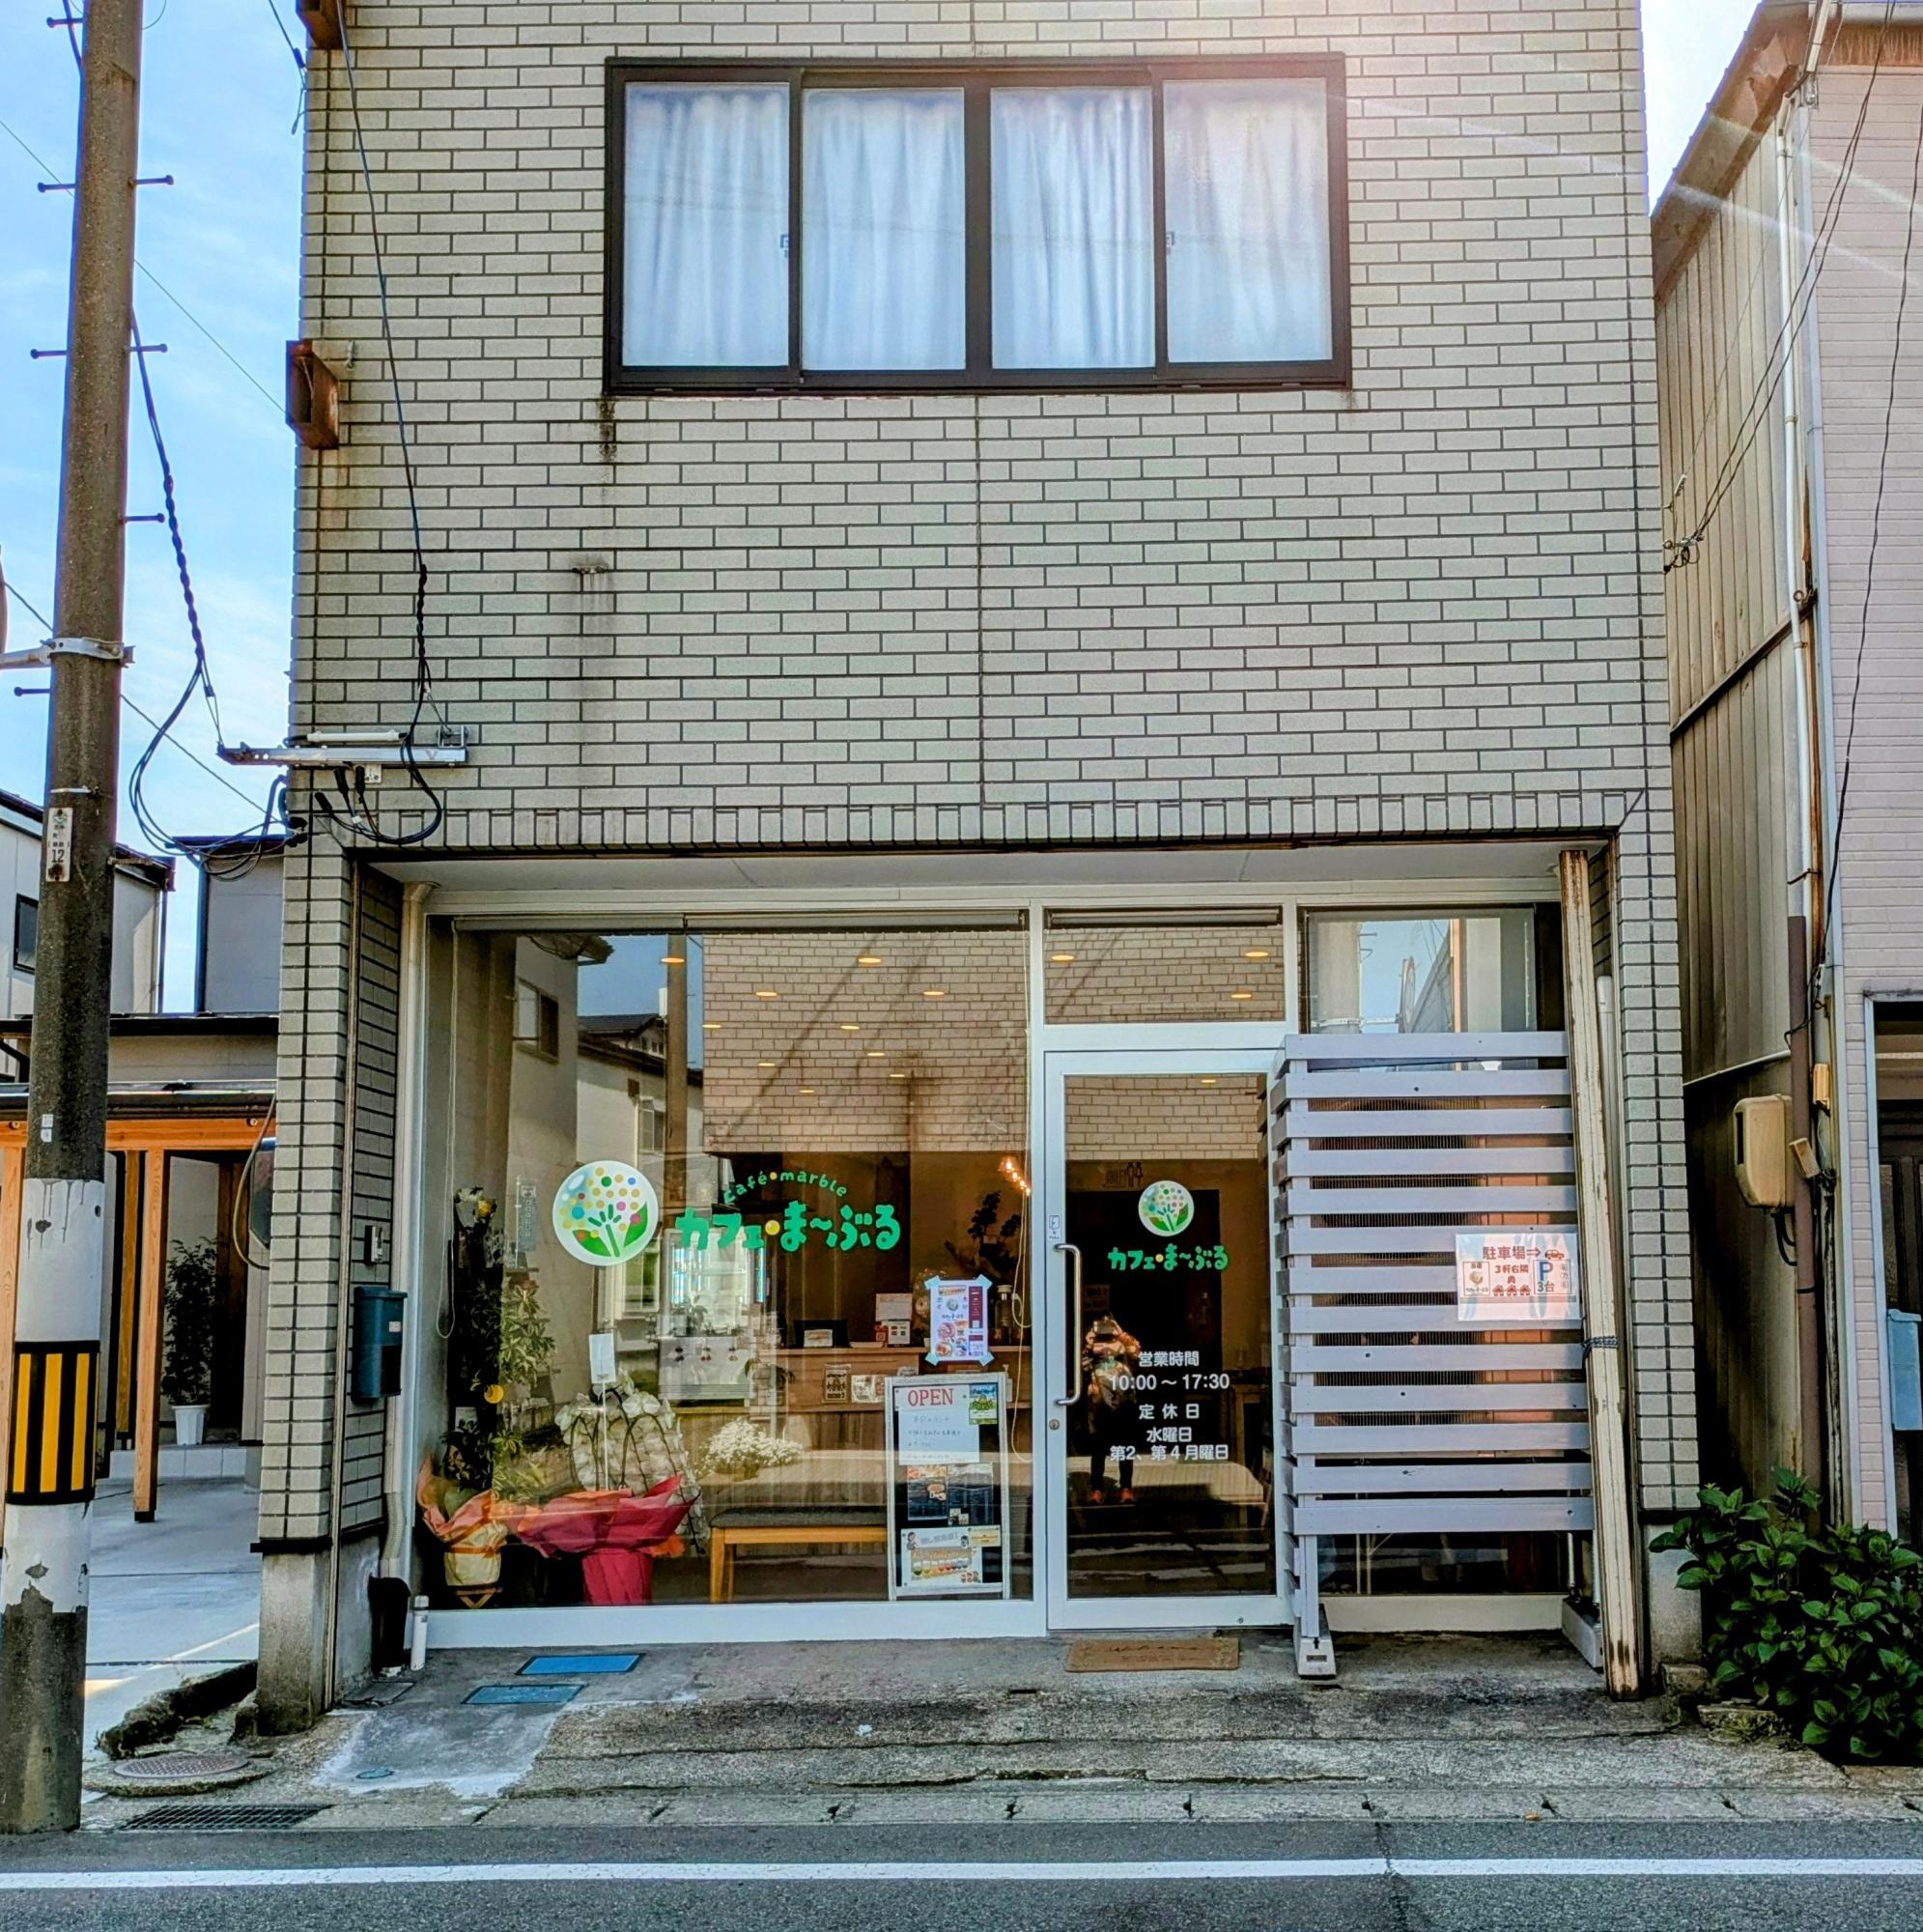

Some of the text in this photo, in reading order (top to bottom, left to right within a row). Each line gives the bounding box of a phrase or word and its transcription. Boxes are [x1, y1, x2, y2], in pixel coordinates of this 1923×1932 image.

[1483, 1245, 1526, 1261] 駐車場
[1539, 1261, 1554, 1282] P
[1139, 1350, 1200, 1368] 営業時間
[908, 1387, 954, 1407] OPEN
[1145, 1426, 1193, 1443] 水曜日
